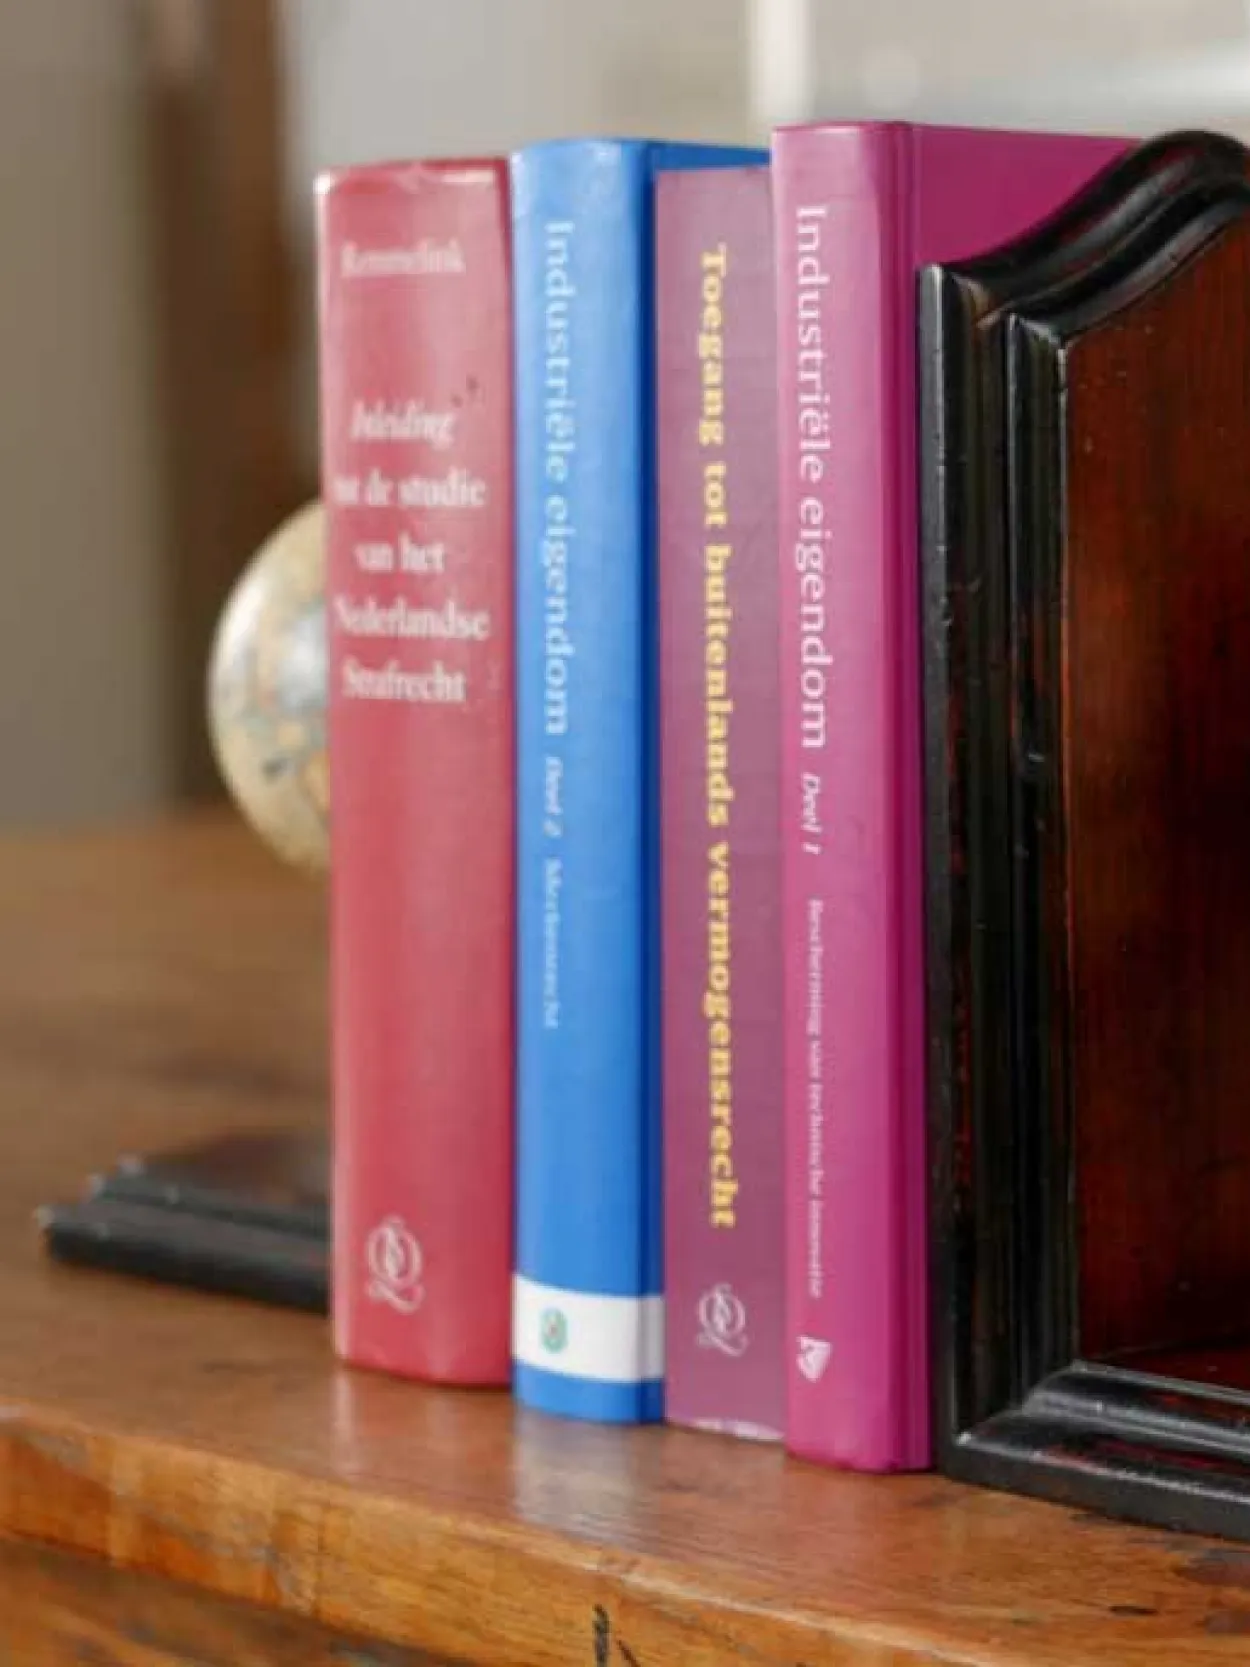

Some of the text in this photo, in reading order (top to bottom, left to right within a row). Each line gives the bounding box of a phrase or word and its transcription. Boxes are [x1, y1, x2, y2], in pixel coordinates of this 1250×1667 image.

[545, 220, 576, 481] Industriële
[797, 204, 830, 483] Industriële
[540, 493, 576, 736] eigendom
[698, 243, 739, 1228] Toegang tot buitenlands vermogensrecht
[795, 497, 832, 748] eigendom
[802, 772, 822, 833] Deel
